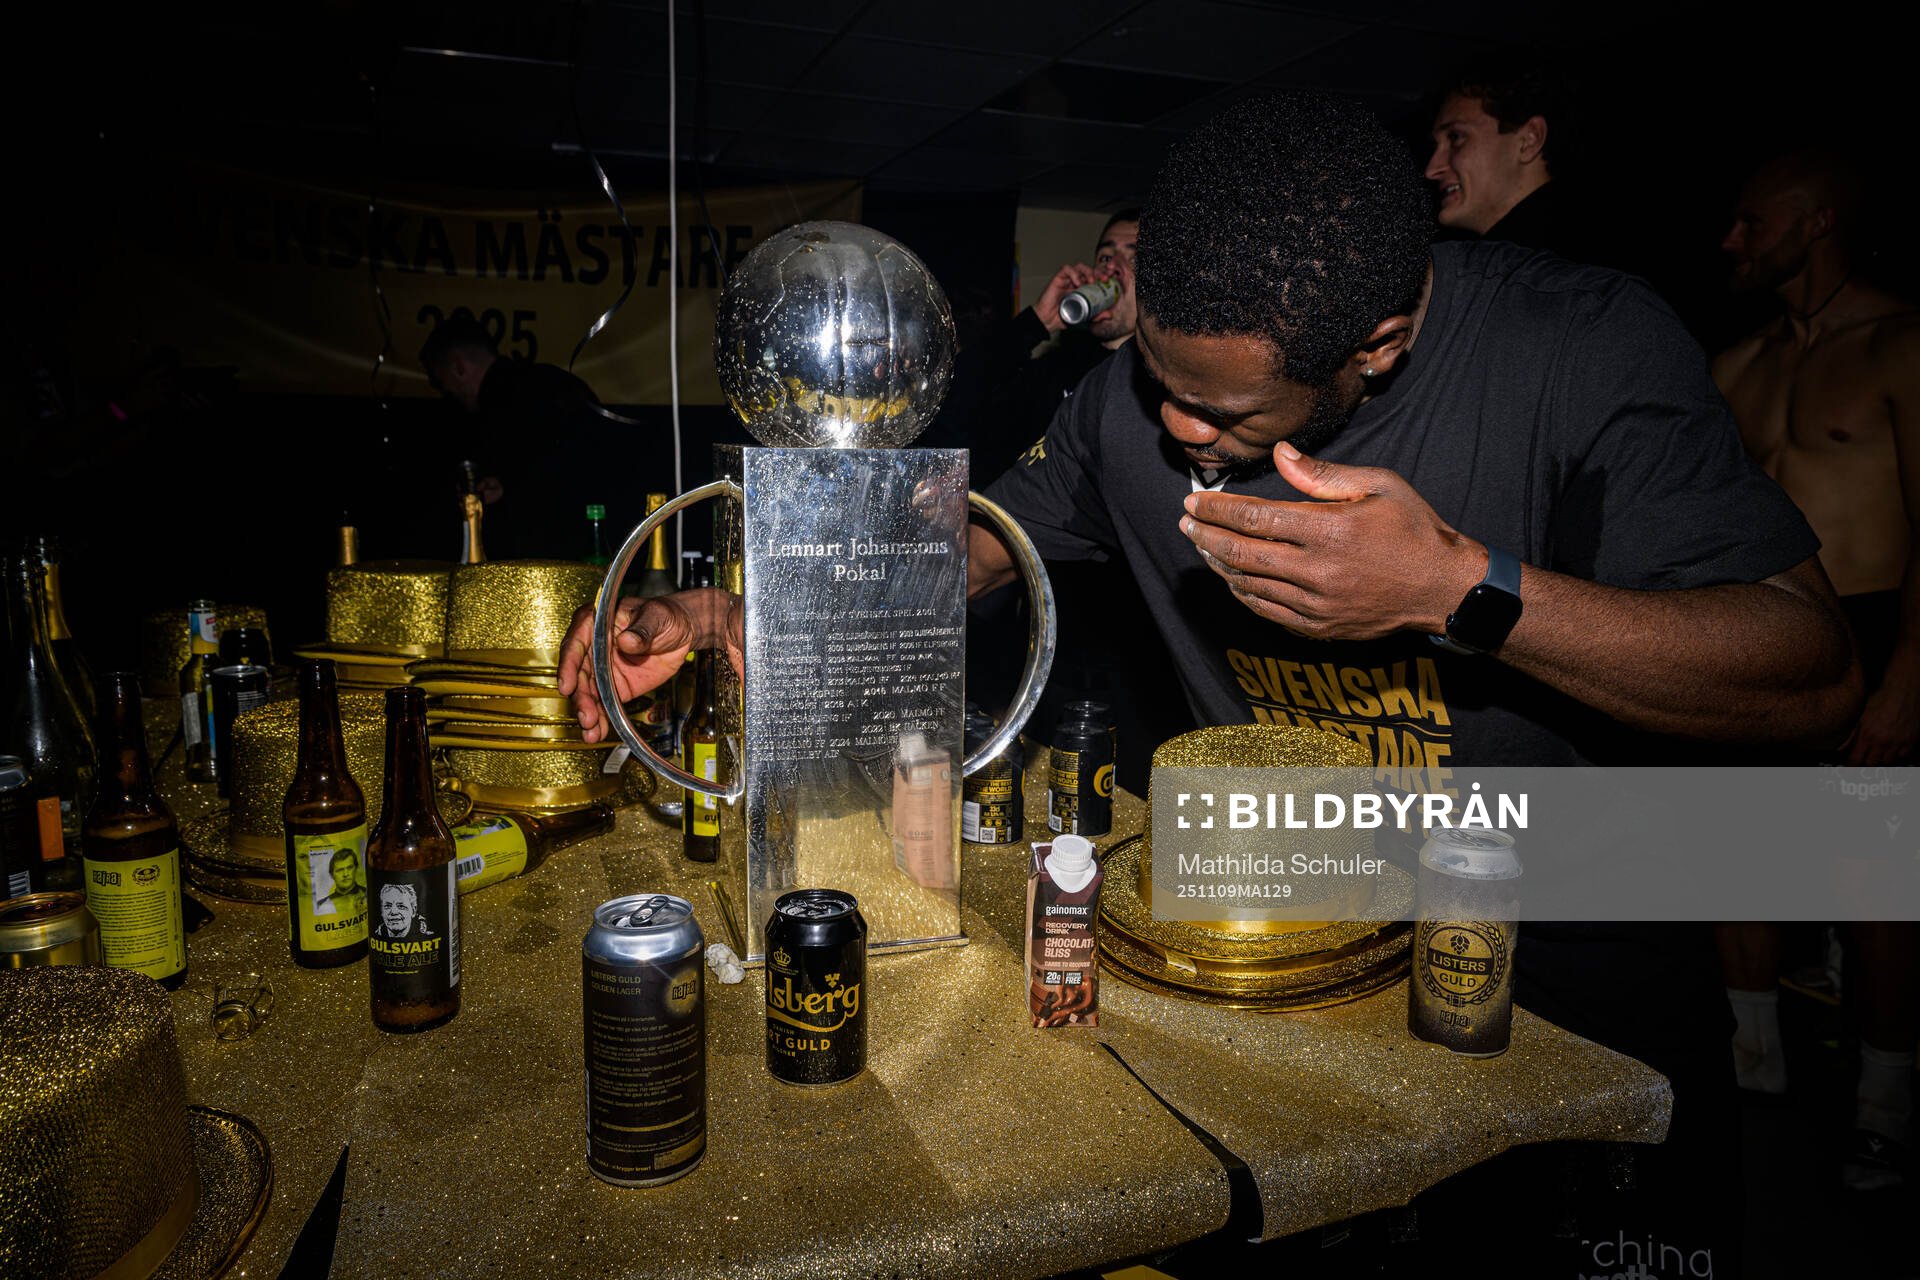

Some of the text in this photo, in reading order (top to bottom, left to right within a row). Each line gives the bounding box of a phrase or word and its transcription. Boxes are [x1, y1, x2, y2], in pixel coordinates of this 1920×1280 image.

[475, 208, 752, 288] MÄSTARE
[417, 304, 537, 366] 225
[767, 539, 843, 557] Lennart
[834, 562, 887, 582] Pokal
[893, 609, 915, 618] SPEL
[916, 608, 937, 617] 2001
[892, 684, 929, 694] MALMÖ
[931, 683, 947, 692] FF
[1226, 647, 1452, 727] SVENSKA
[824, 700, 845, 709] 2018
[847, 699, 869, 708] AIK
[873, 711, 896, 720] 2020
[901, 707, 933, 718] MALMÖ
[935, 707, 946, 717] FF
[861, 725, 884, 734] 2022
[829, 738, 850, 747] 2024
[855, 735, 886, 746] MALMÖ
[1251, 706, 1459, 800] TARE
[1045, 905, 1088, 917] gainomax
[314, 911, 368, 933] GULSVART
[1045, 922, 1088, 930] RECOVERY
[370, 937, 442, 955] GULSVART
[1044, 948, 1071, 958] BLISS
[407, 950, 440, 967] ALE
[1432, 953, 1487, 972] LISTERS
[618, 976, 641, 984] GULD
[1065, 976, 1082, 985] FREE
[1439, 972, 1477, 988] GULD
[617, 987, 641, 996] LAGER
[785, 1037, 831, 1051] GULD
[1581, 1229, 1713, 1280] ching
